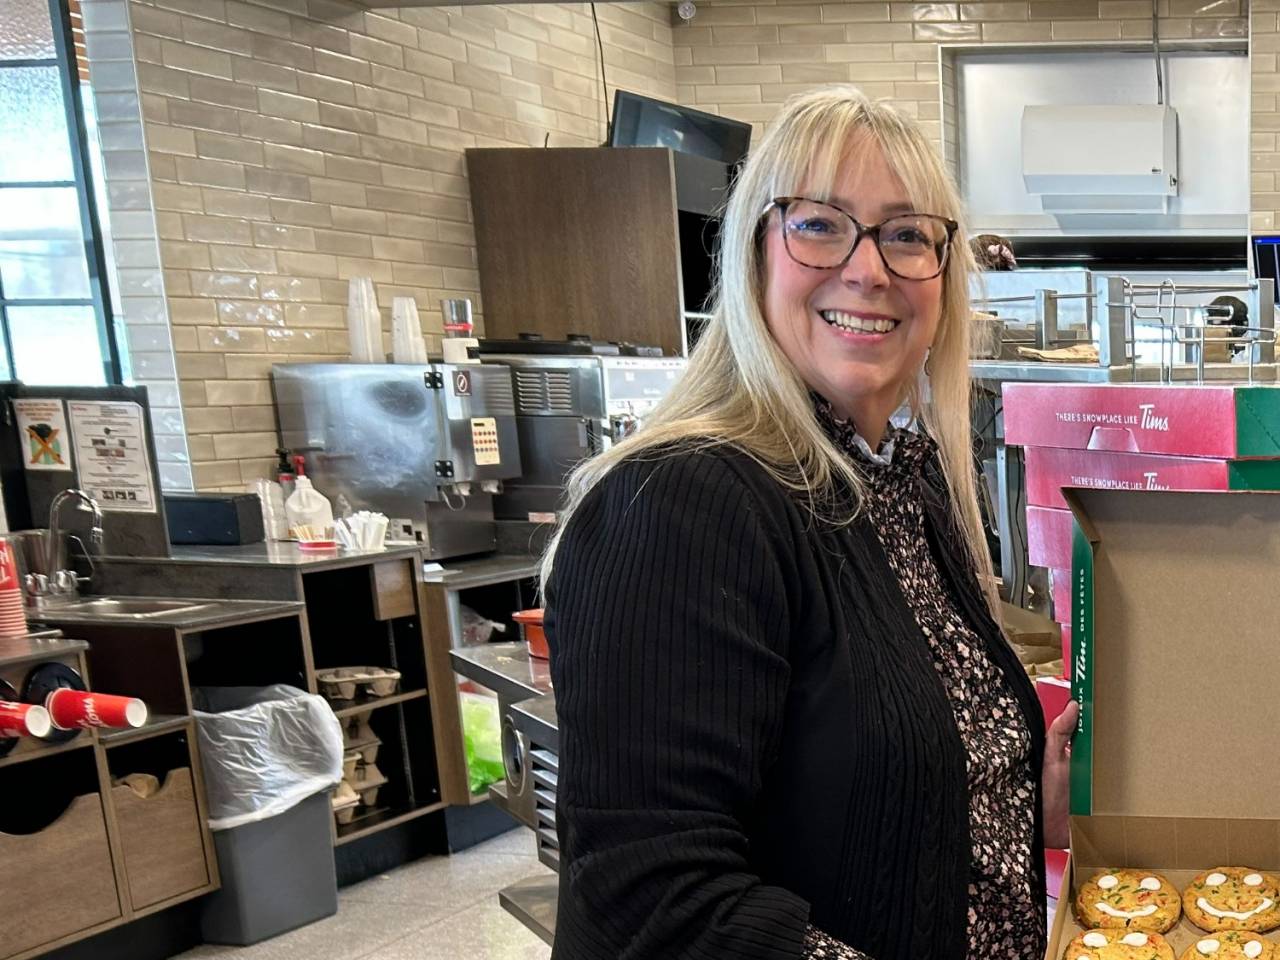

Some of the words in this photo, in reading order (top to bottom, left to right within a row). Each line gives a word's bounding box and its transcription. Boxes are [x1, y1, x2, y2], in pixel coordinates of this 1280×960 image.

[1056, 412, 1081, 422] THERE'S
[1124, 415, 1138, 425] LIKE
[1139, 403, 1169, 432] Tims
